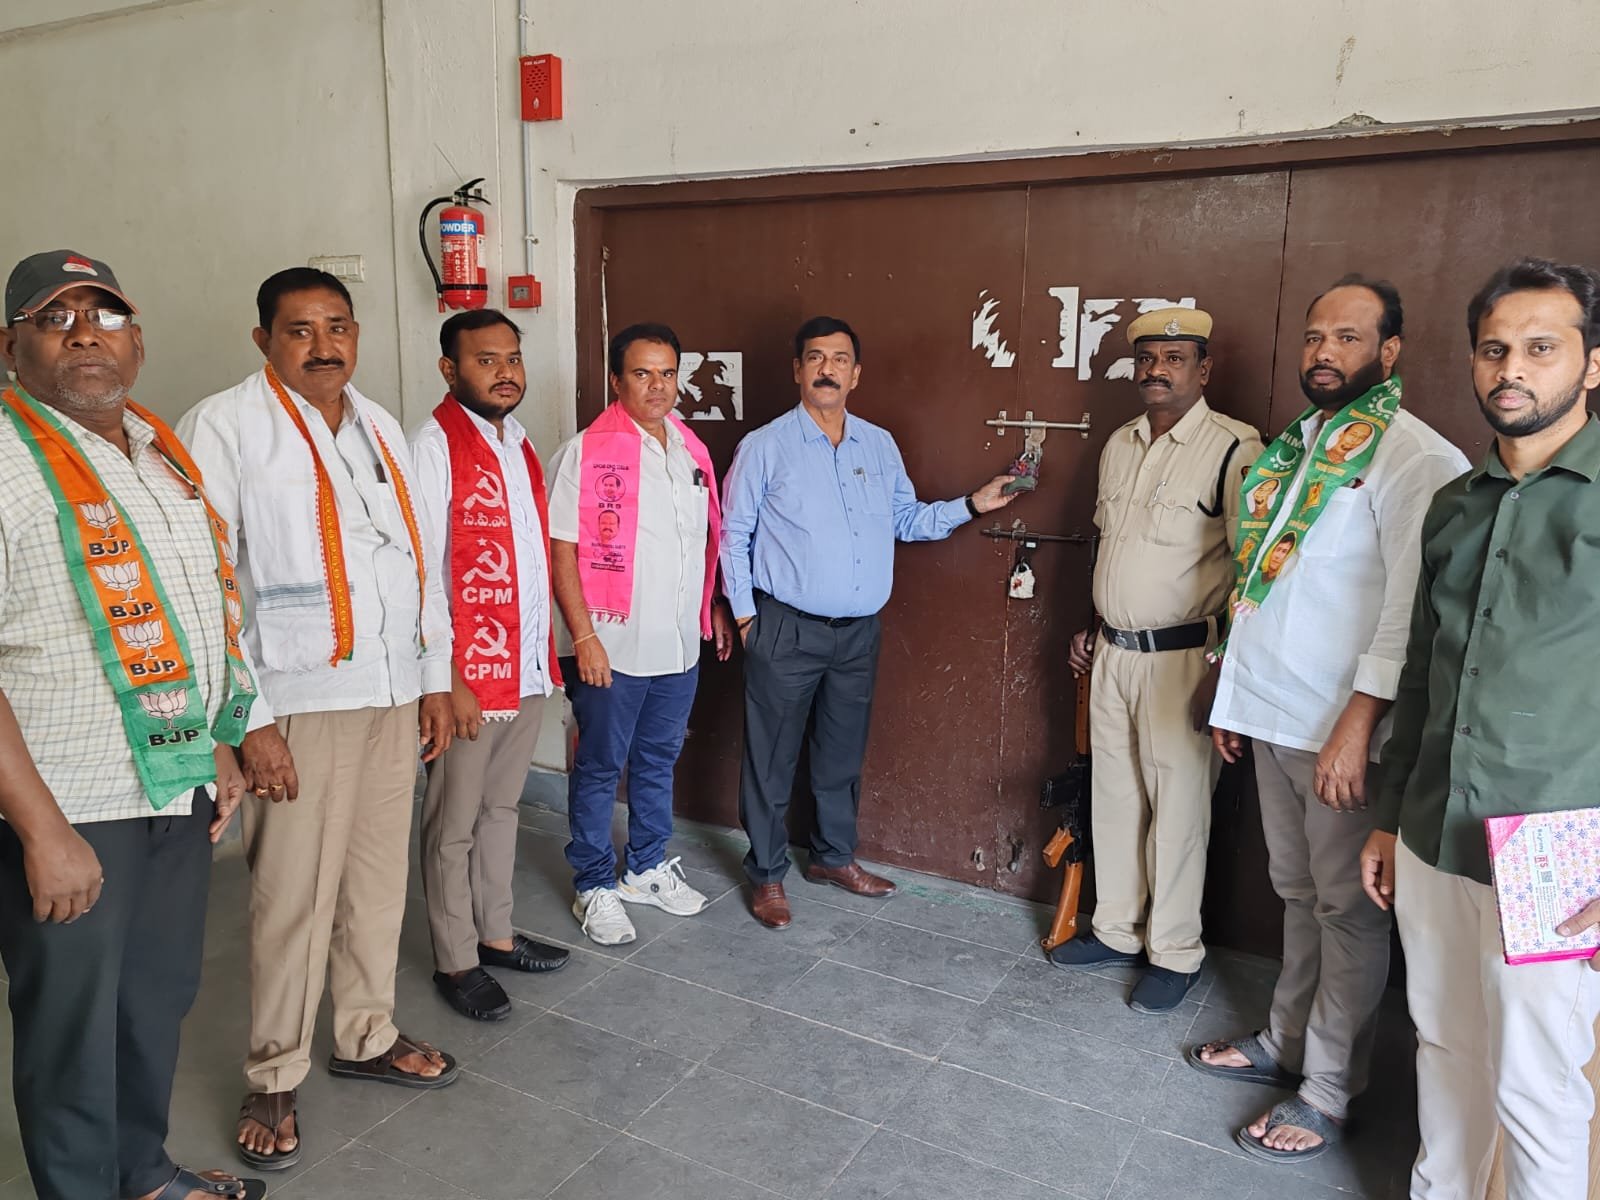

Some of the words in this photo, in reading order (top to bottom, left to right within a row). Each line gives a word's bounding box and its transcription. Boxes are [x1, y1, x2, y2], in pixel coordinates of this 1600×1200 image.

[88, 540, 130, 557] BJP
[462, 587, 513, 604] CPM
[108, 602, 155, 618] BJP
[129, 660, 177, 676] BJP
[464, 663, 512, 681] CPM
[148, 729, 200, 747] BJP
